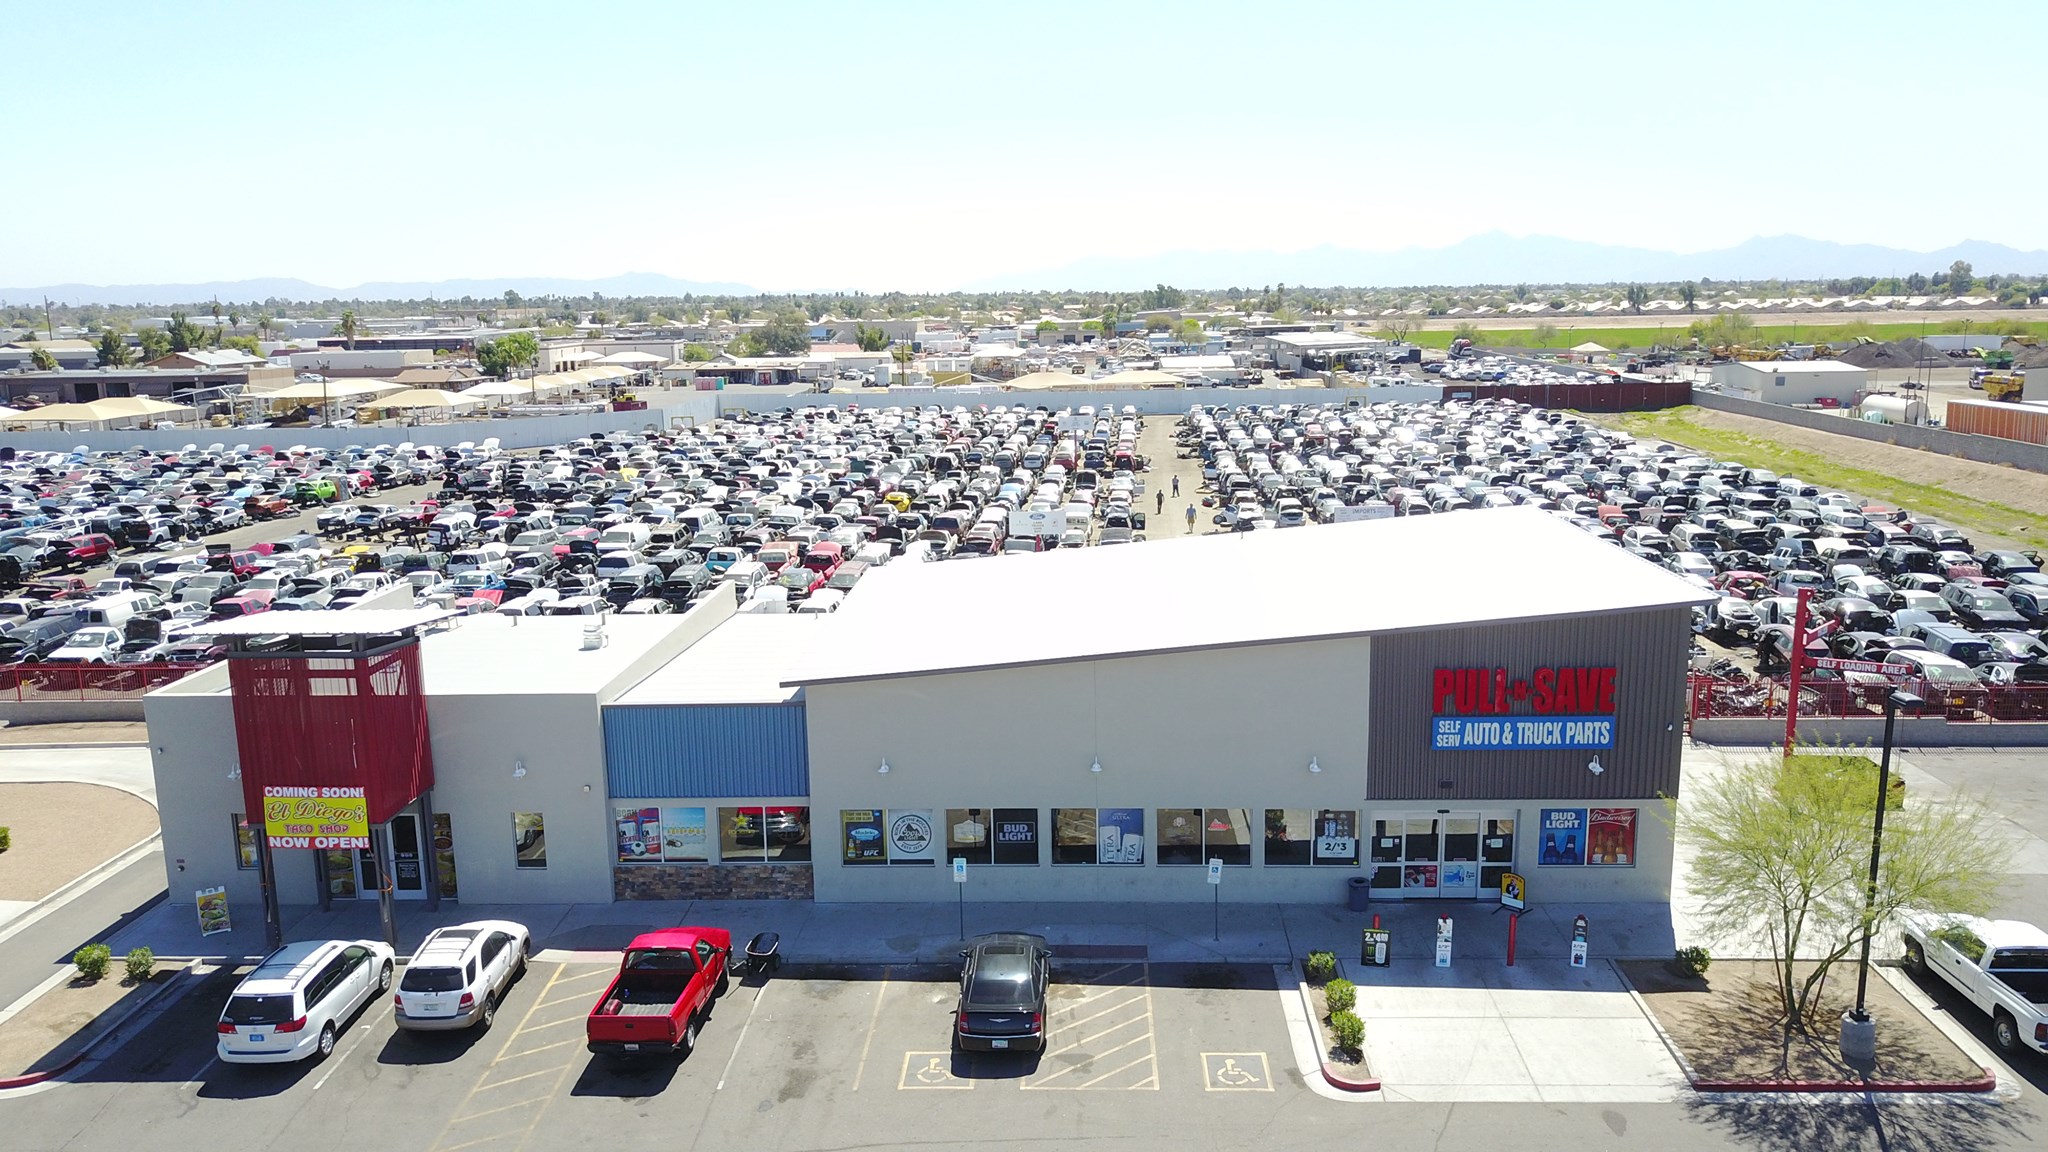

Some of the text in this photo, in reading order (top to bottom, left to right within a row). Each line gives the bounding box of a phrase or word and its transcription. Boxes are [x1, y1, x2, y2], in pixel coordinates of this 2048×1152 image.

[1817, 660, 1907, 674] SELF LOADING AREA
[1438, 720, 1461, 733] SELF
[1463, 721, 1611, 745] AUTO & TRUCK PARTS
[1436, 734, 1461, 747] SERV
[264, 786, 364, 797] COMING SOON!
[267, 798, 365, 823] El Diego's
[1551, 812, 1576, 820] BUD
[1592, 813, 1631, 822] Budweiser
[284, 824, 349, 834] TACO SHOP
[1003, 824, 1028, 832] BUD
[1545, 820, 1580, 829] LIGHT
[999, 832, 1033, 841] LIGHT
[269, 837, 369, 848] NOW OPEN!
